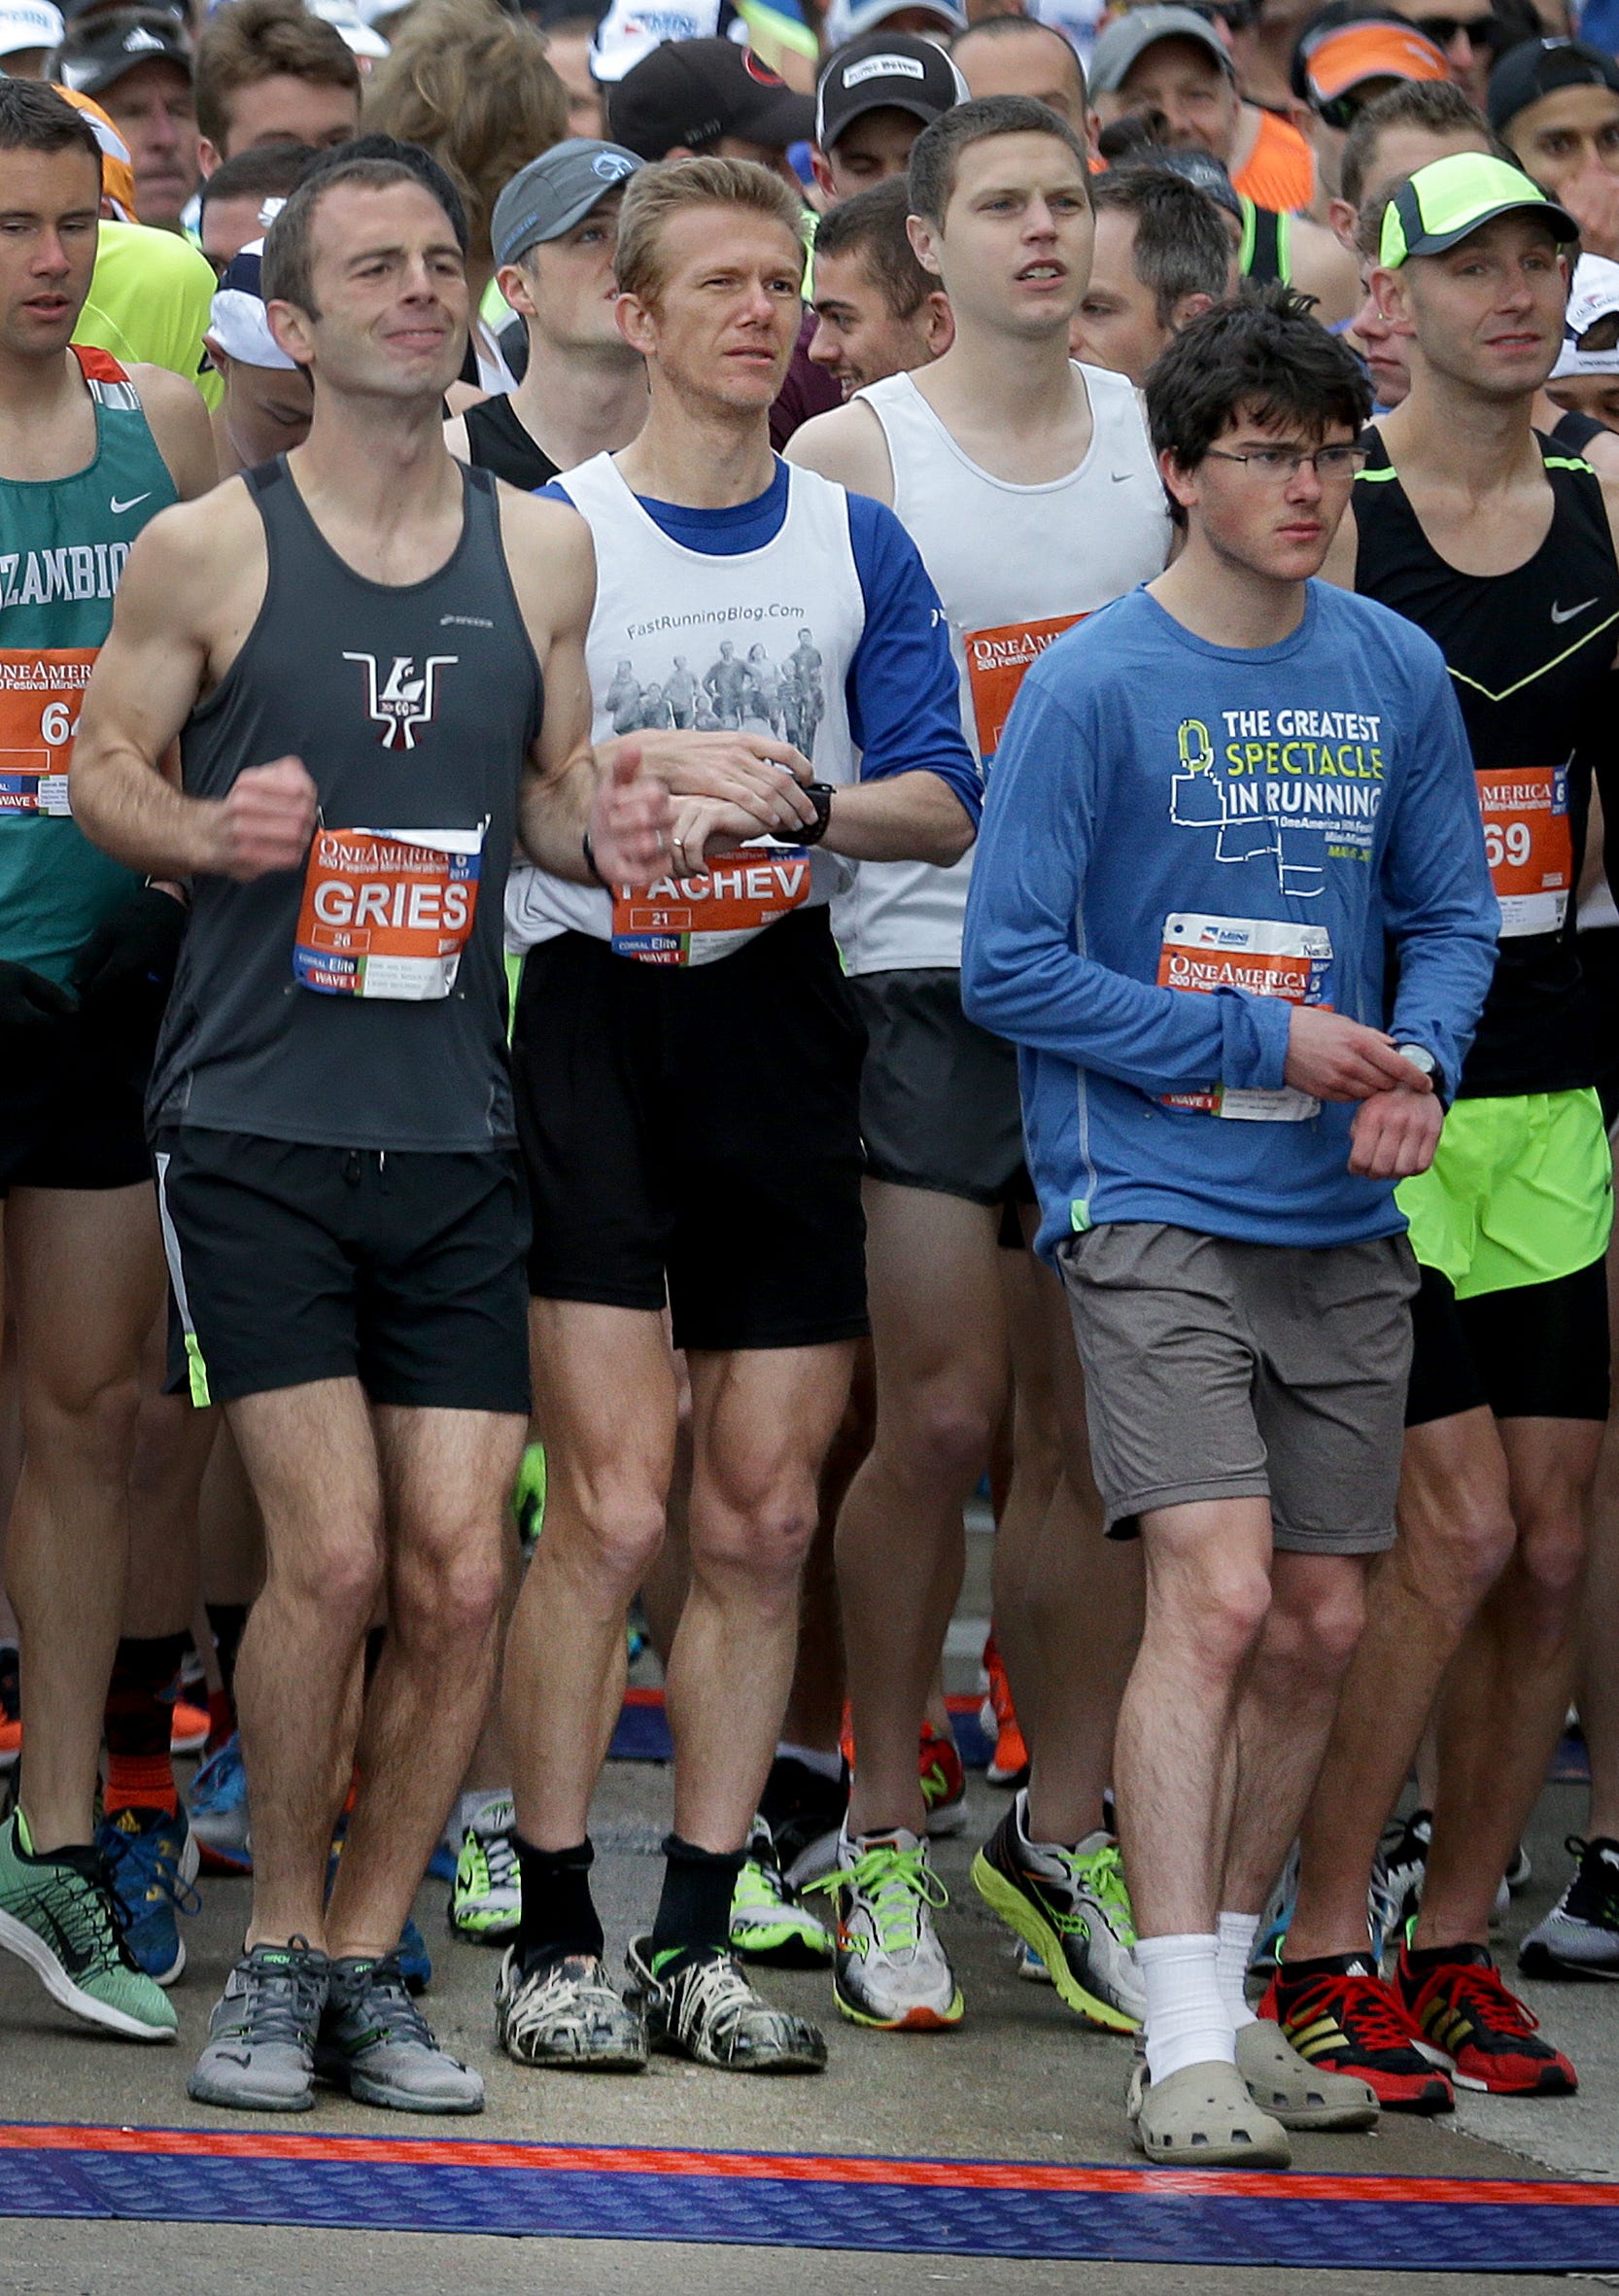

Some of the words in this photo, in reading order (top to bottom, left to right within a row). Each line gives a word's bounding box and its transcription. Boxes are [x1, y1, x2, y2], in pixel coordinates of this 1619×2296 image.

[0, 541, 136, 610] ZAMBI
[627, 604, 805, 640] FastRunningBlog.Com
[0, 660, 92, 679] NEAMER
[978, 657, 996, 671] 500
[6, 678, 49, 690] Festival
[1222, 710, 1271, 738] THE
[1276, 710, 1381, 743] GREATEST
[1225, 741, 1384, 781] SPECTACLE
[0, 795, 30, 807] WAVE
[1229, 782, 1259, 815] IN
[1265, 781, 1382, 818] RUNNING
[1280, 817, 1341, 830] OneAmerica
[319, 854, 337, 870] 500
[314, 879, 468, 930] GRIES
[652, 912, 669, 925] 21
[650, 937, 677, 950] Elite
[1218, 930, 1249, 942] MINI
[328, 957, 355, 973] Elite
[638, 951, 672, 963] WAVE
[673, 952, 680, 962] 1
[314, 972, 348, 987] WAVE
[350, 975, 357, 989] 1
[1168, 973, 1189, 986] 500
[1310, 975, 1321, 992] 6
[1170, 1095, 1204, 1107] WAVE
[1206, 1096, 1214, 1107] 1
